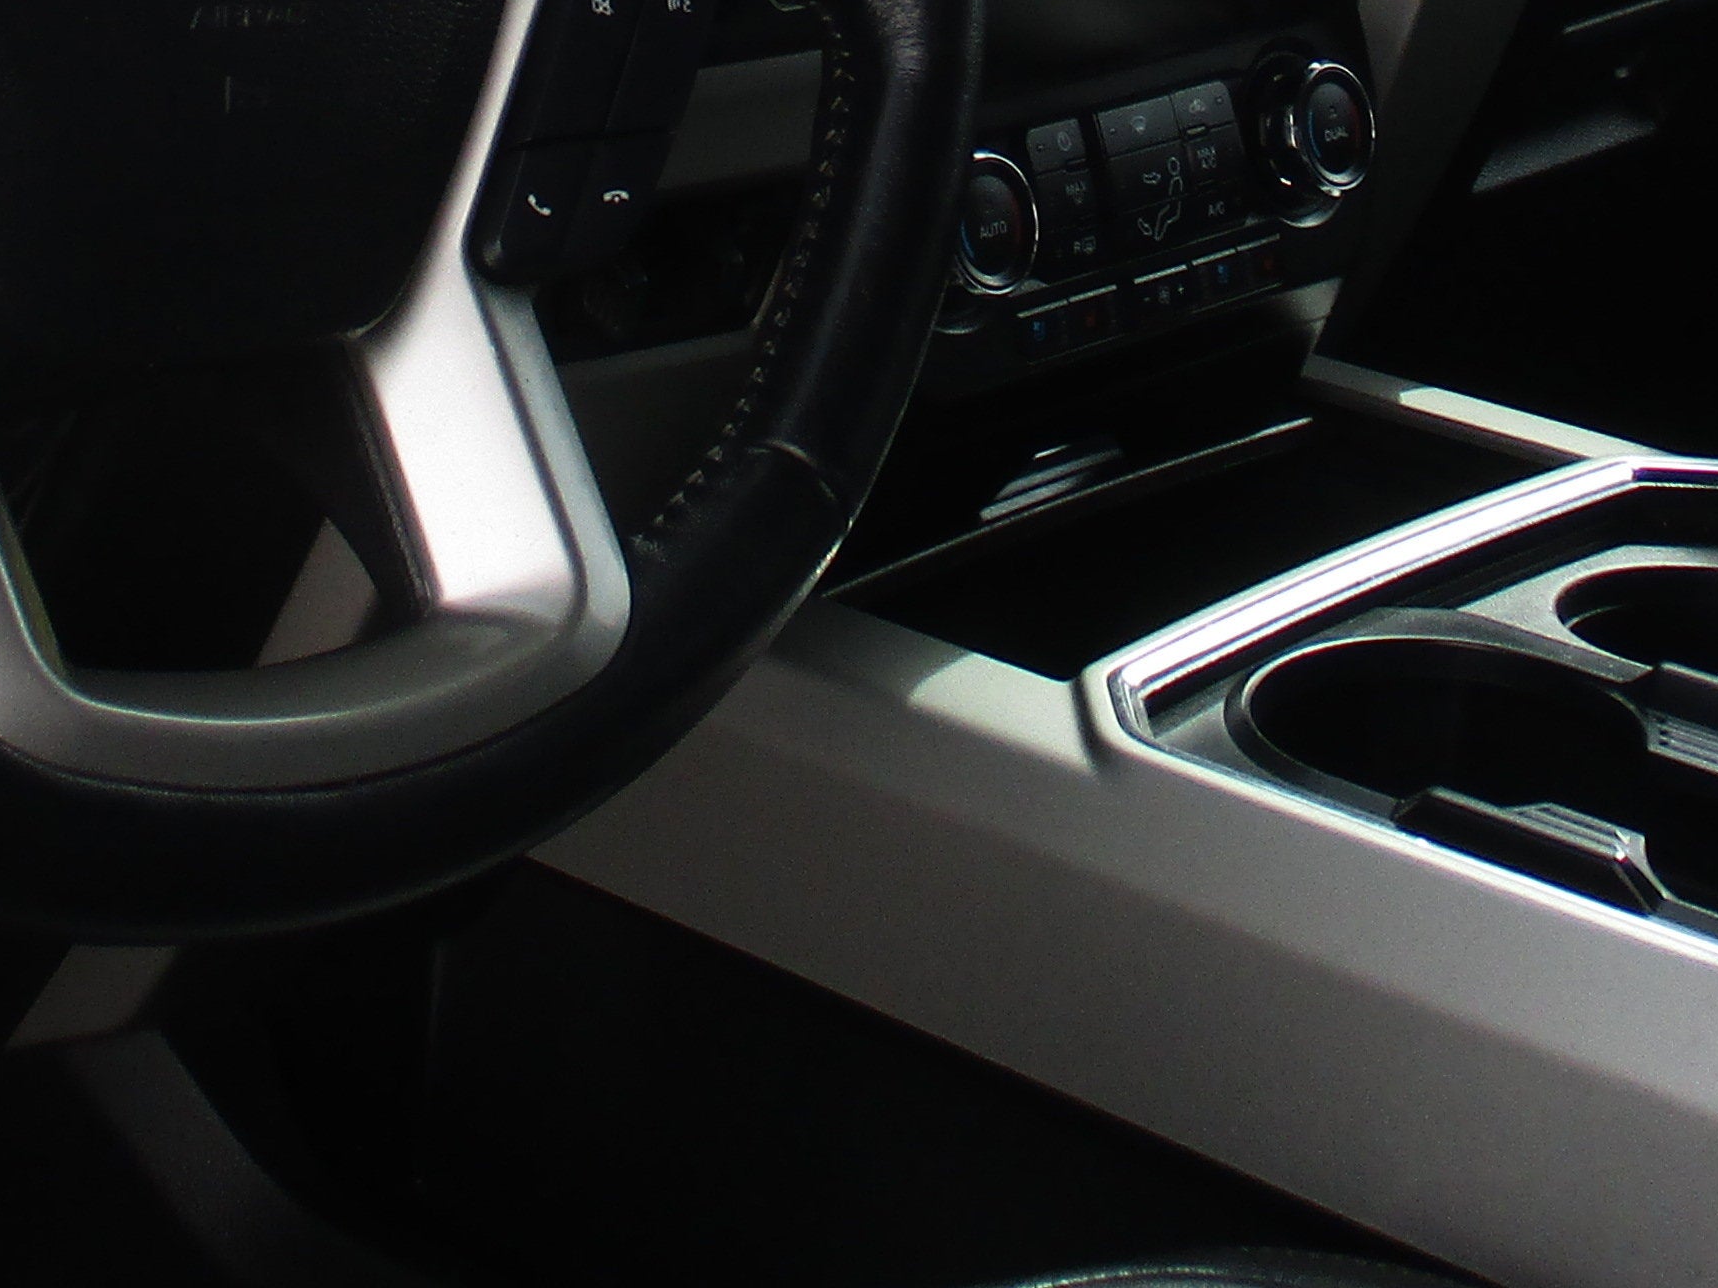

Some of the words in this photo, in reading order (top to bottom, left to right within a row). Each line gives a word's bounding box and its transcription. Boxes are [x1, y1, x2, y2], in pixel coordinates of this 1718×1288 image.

[1323, 124, 1349, 144] DUAL
[1207, 200, 1227, 217] A/C
[979, 221, 1008, 240] AUTO
